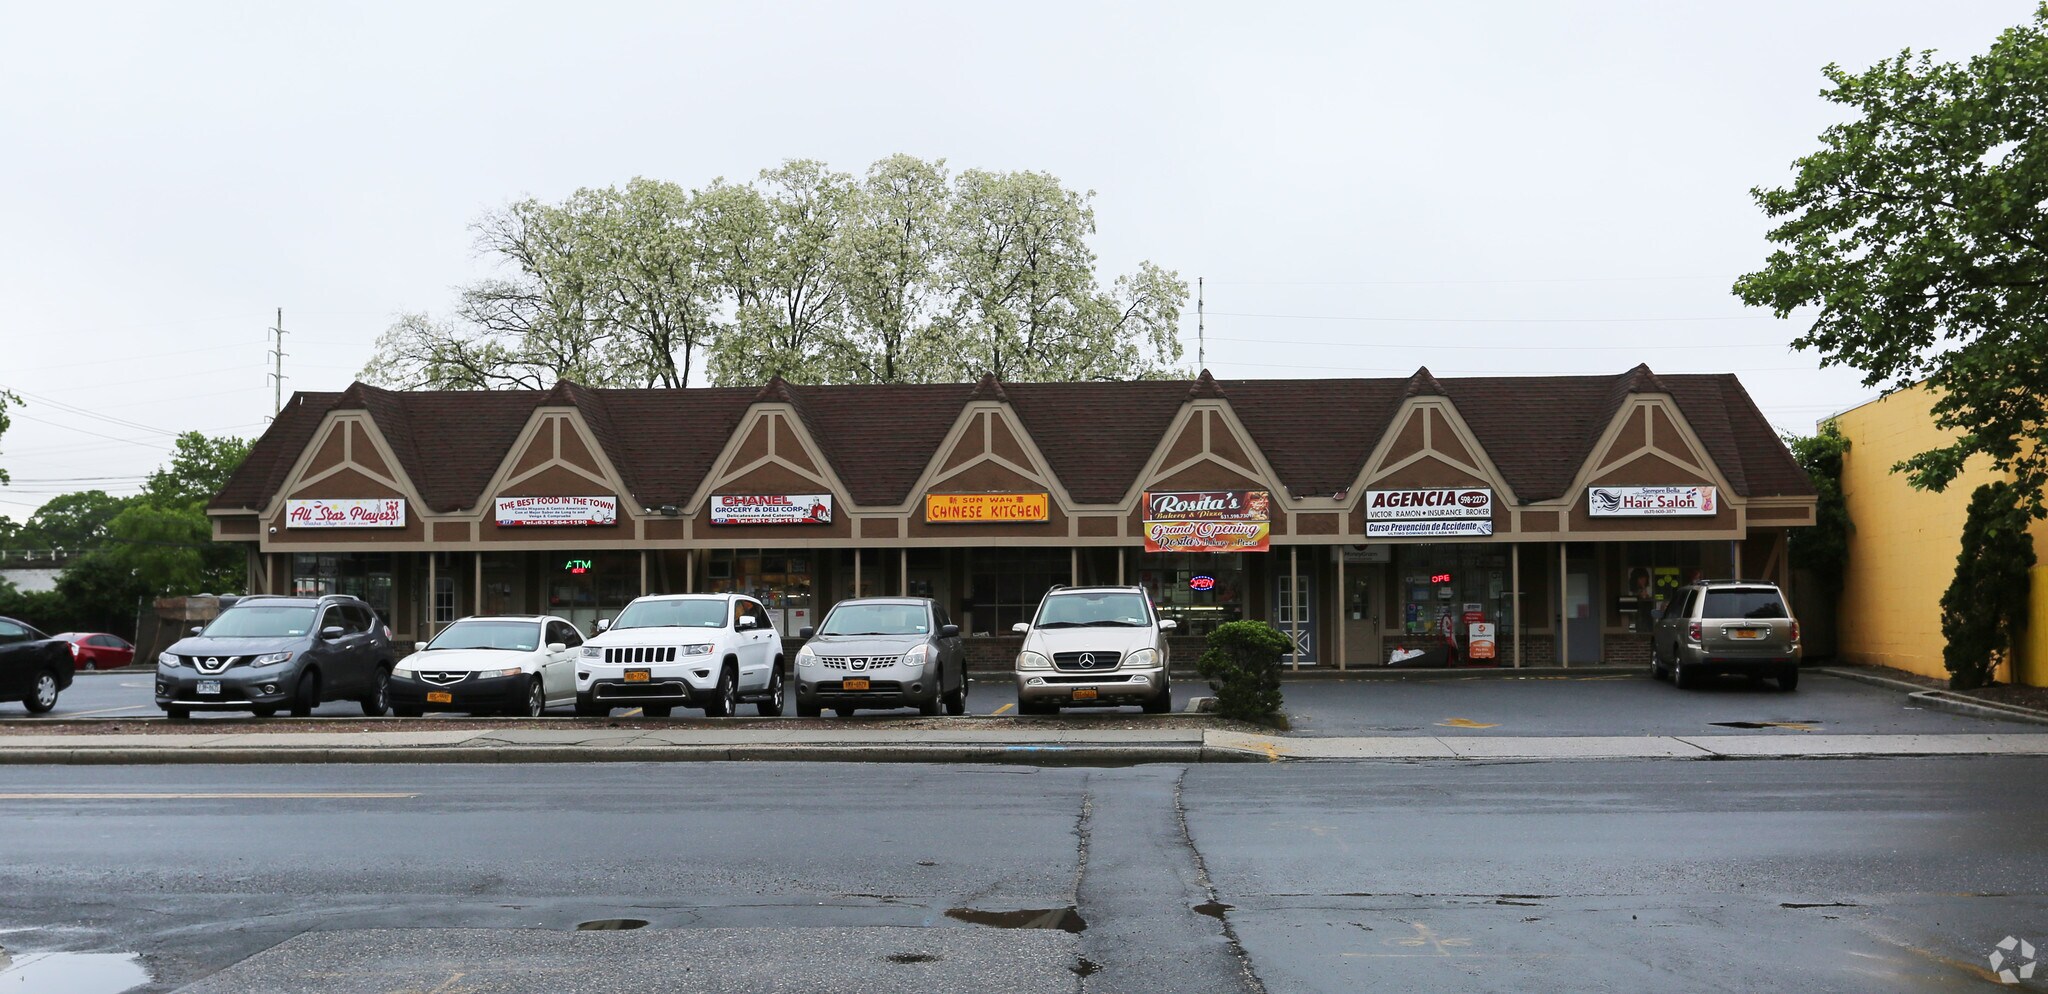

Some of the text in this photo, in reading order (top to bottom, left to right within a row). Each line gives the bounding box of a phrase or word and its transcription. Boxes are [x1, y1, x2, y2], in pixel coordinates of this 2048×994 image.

[1642, 487, 1665, 495] Siempre
[500, 500, 515, 510] THE
[517, 498, 535, 507] BEST
[538, 496, 560, 504] FOOD
[590, 498, 614, 510] TOWN
[722, 496, 793, 506] CHANEL
[1153, 492, 1240, 513] Rosita's
[1372, 491, 1456, 508] AGENCIA
[1460, 496, 1487, 504] 598-2273
[1624, 496, 1653, 508] Hair
[1658, 496, 1695, 508] Salon
[290, 506, 396, 523] All Star Players
[932, 504, 1040, 518] CHINESE KITCHEN
[1150, 522, 1260, 541] Grand Opening
[1369, 524, 1389, 532] Curso
[1391, 523, 1430, 532] Prevención
[1442, 522, 1477, 530] Accidente
[1157, 536, 1200, 552] Rosita's
[565, 560, 591, 569] ATM
[1191, 579, 1214, 588] OPEN
